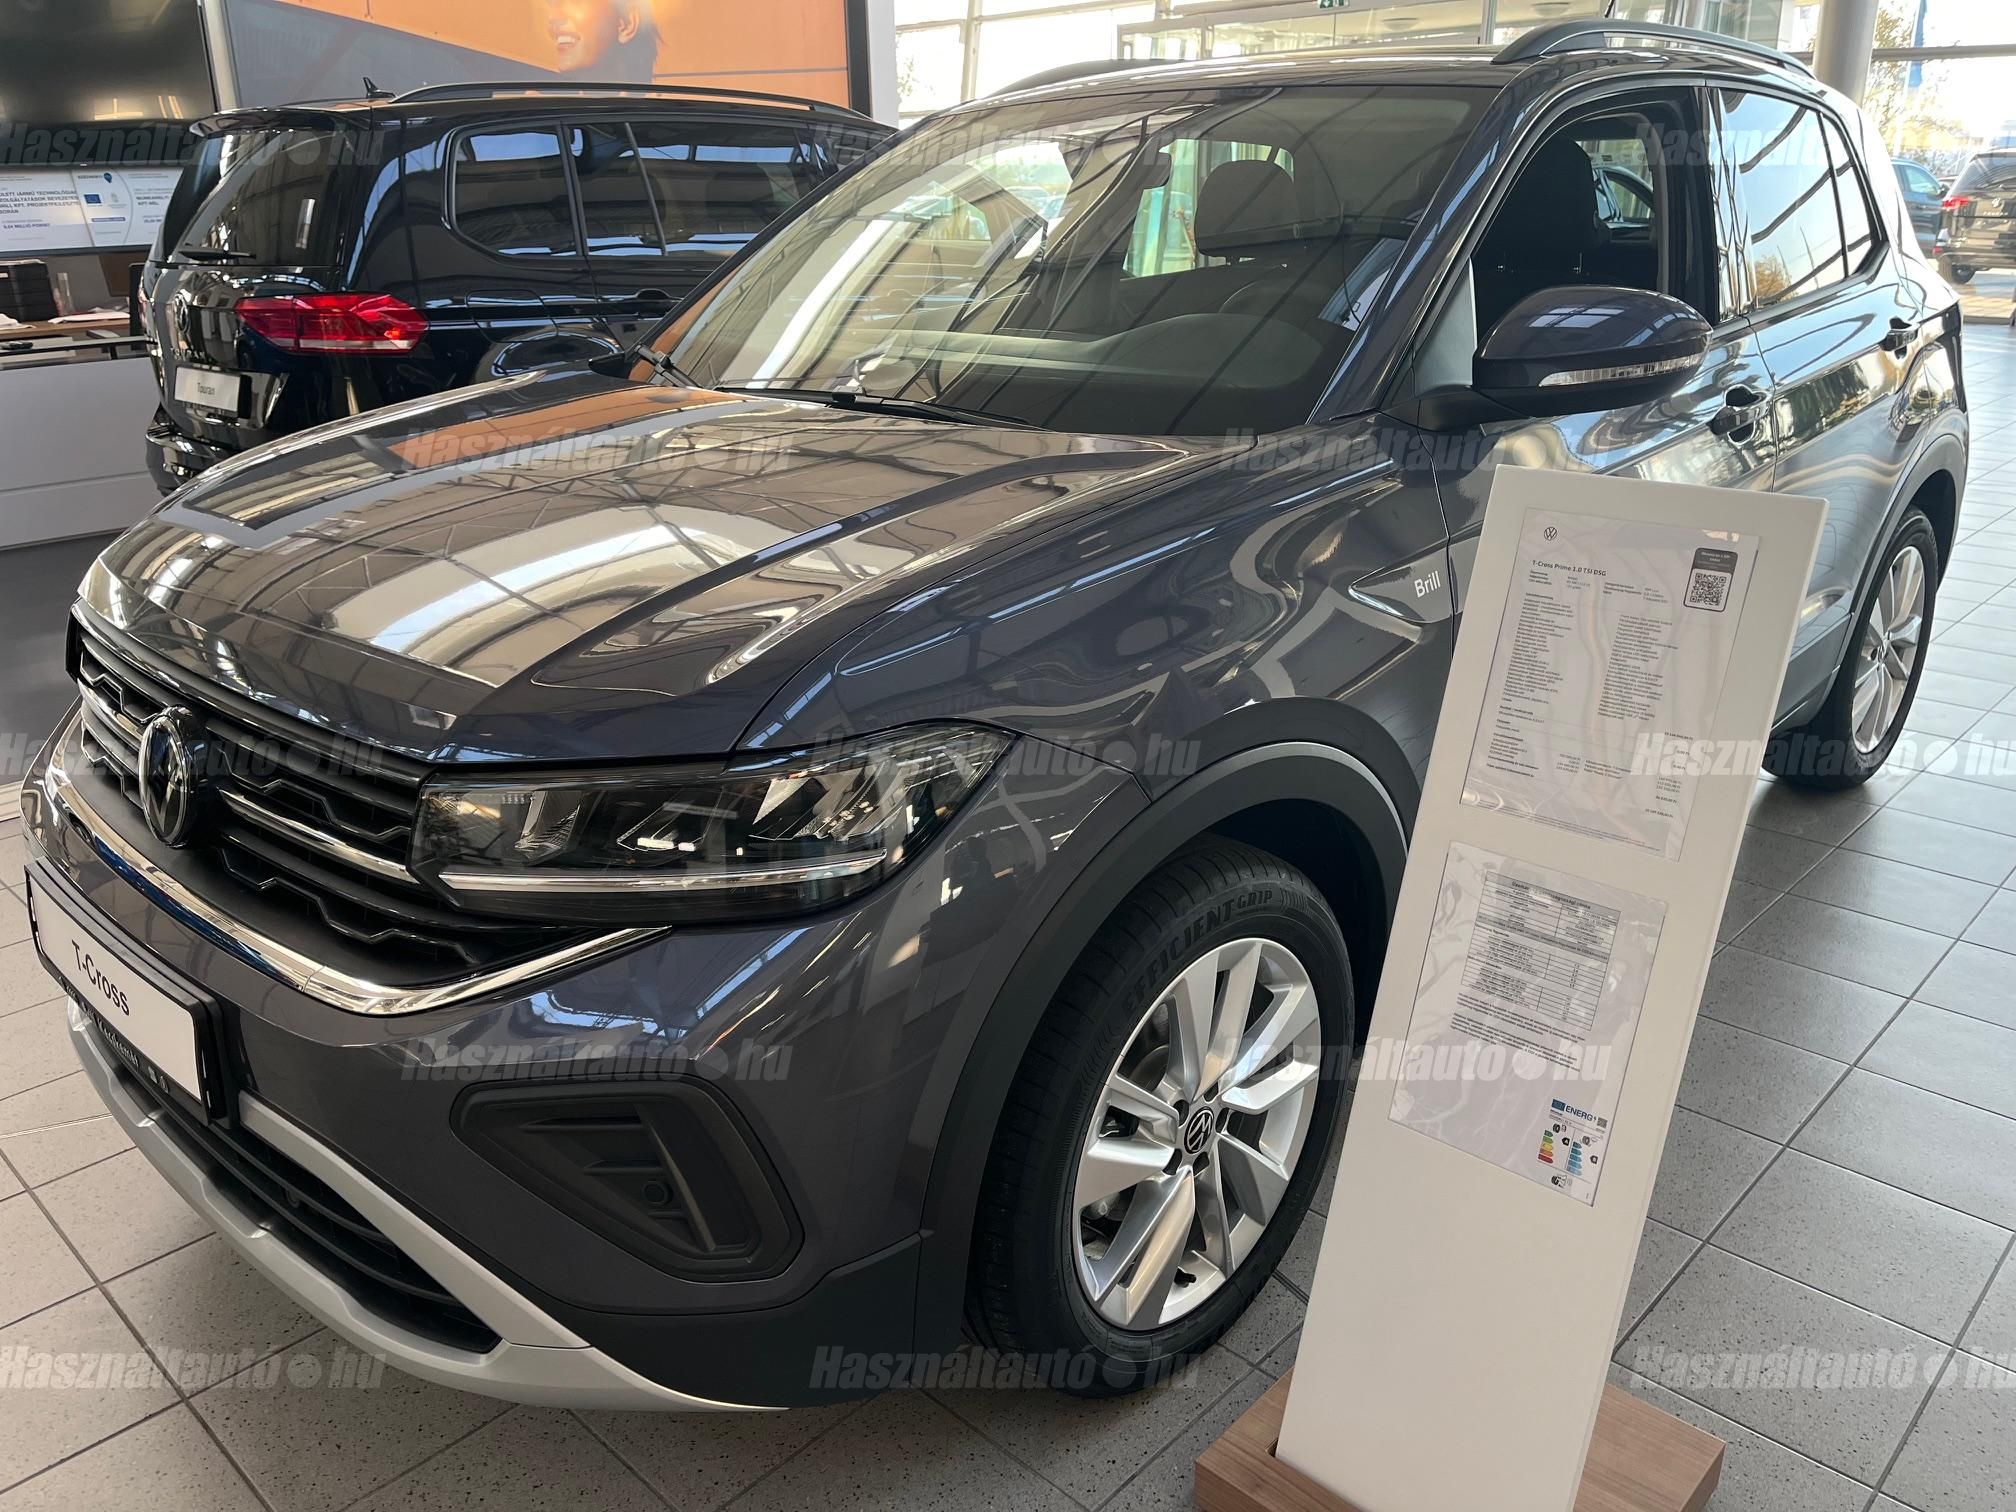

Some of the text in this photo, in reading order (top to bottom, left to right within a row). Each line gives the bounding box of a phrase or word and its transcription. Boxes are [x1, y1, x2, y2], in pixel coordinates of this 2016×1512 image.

[1532, 559, 1553, 569] T-Cross
[1554, 563, 1571, 571] Prime
[1414, 570, 1441, 598] Brill
[71, 939, 130, 1016] T-Cross
